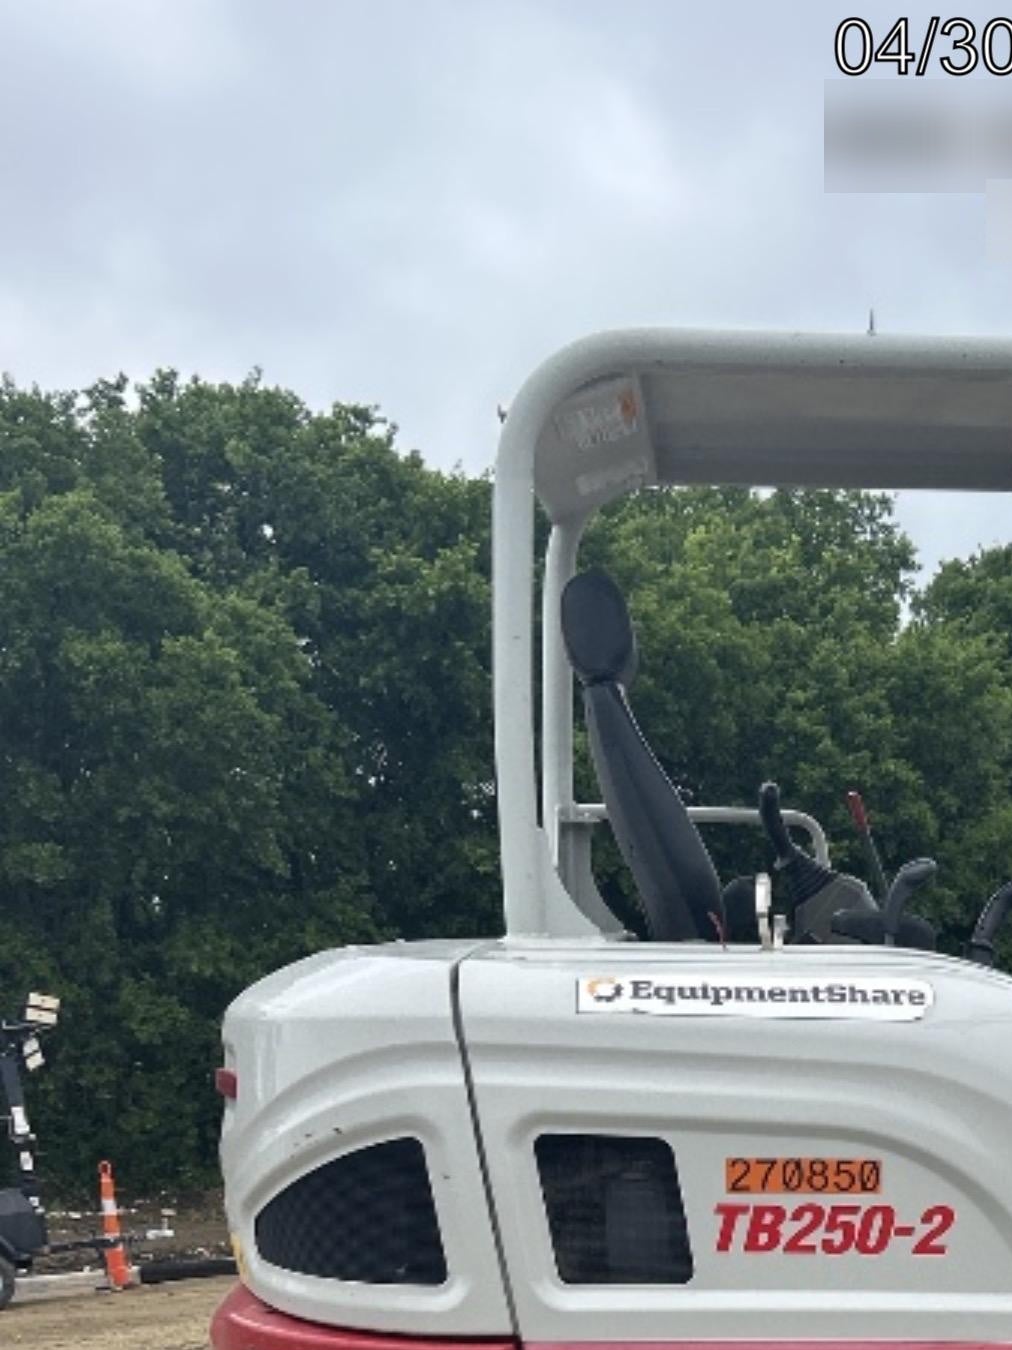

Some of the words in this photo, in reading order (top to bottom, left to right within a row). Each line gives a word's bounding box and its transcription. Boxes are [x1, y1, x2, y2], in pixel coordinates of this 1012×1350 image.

[629, 980, 926, 1006] EquipmentShare
[729, 1158, 881, 1192] 270850
[714, 1202, 956, 1255] TB250-2
